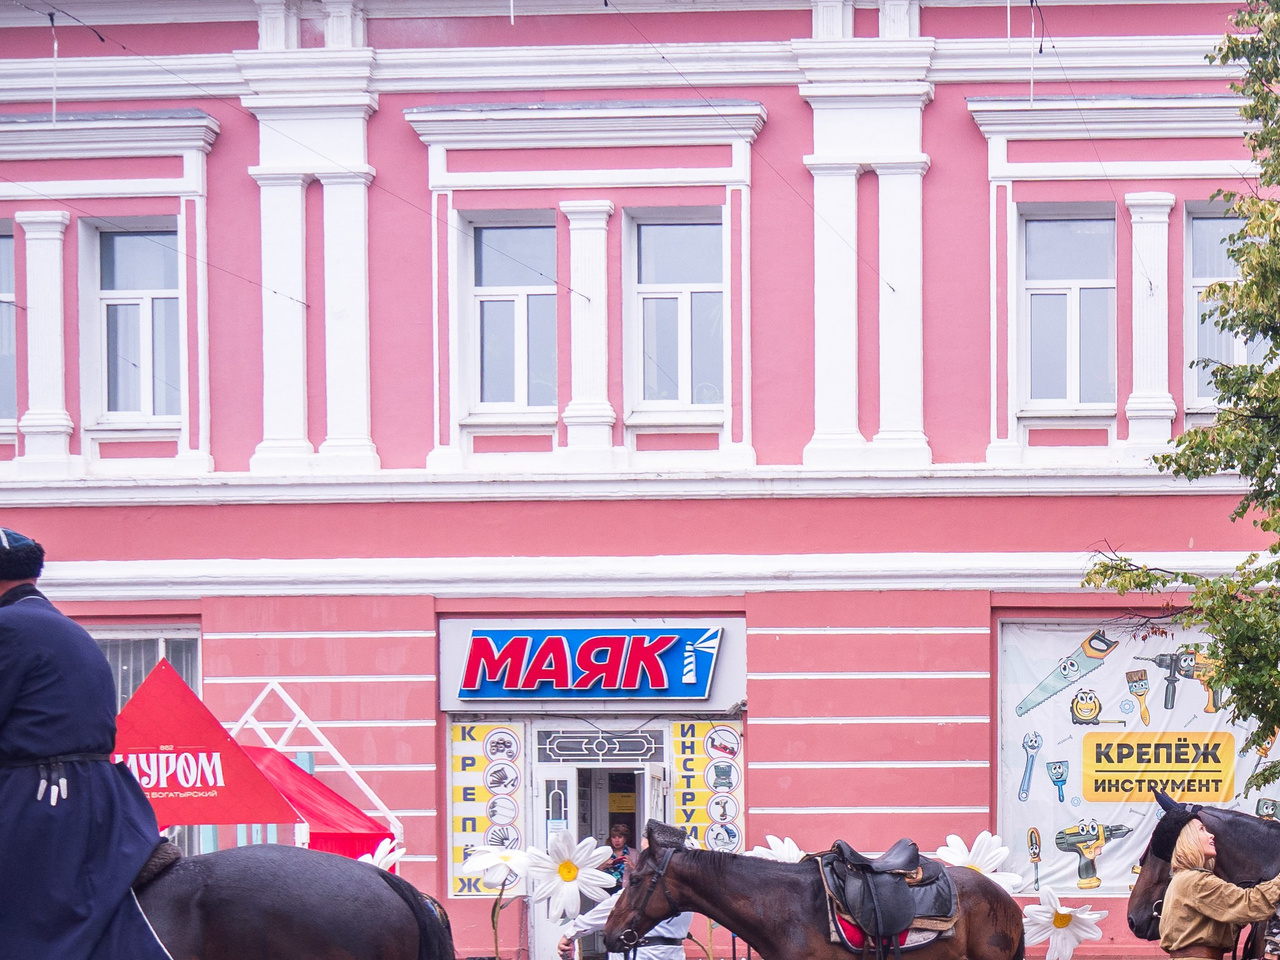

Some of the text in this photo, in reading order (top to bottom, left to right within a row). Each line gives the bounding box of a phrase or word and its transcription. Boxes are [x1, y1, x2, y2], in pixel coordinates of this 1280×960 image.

[462, 634, 679, 691] МАЯК
[1095, 738, 1221, 764] КРЕПЁЖ
[151, 790, 218, 799] БОГАТЫРСКИЙ
[1094, 779, 1223, 793] ИНСТРУМЕНТ
